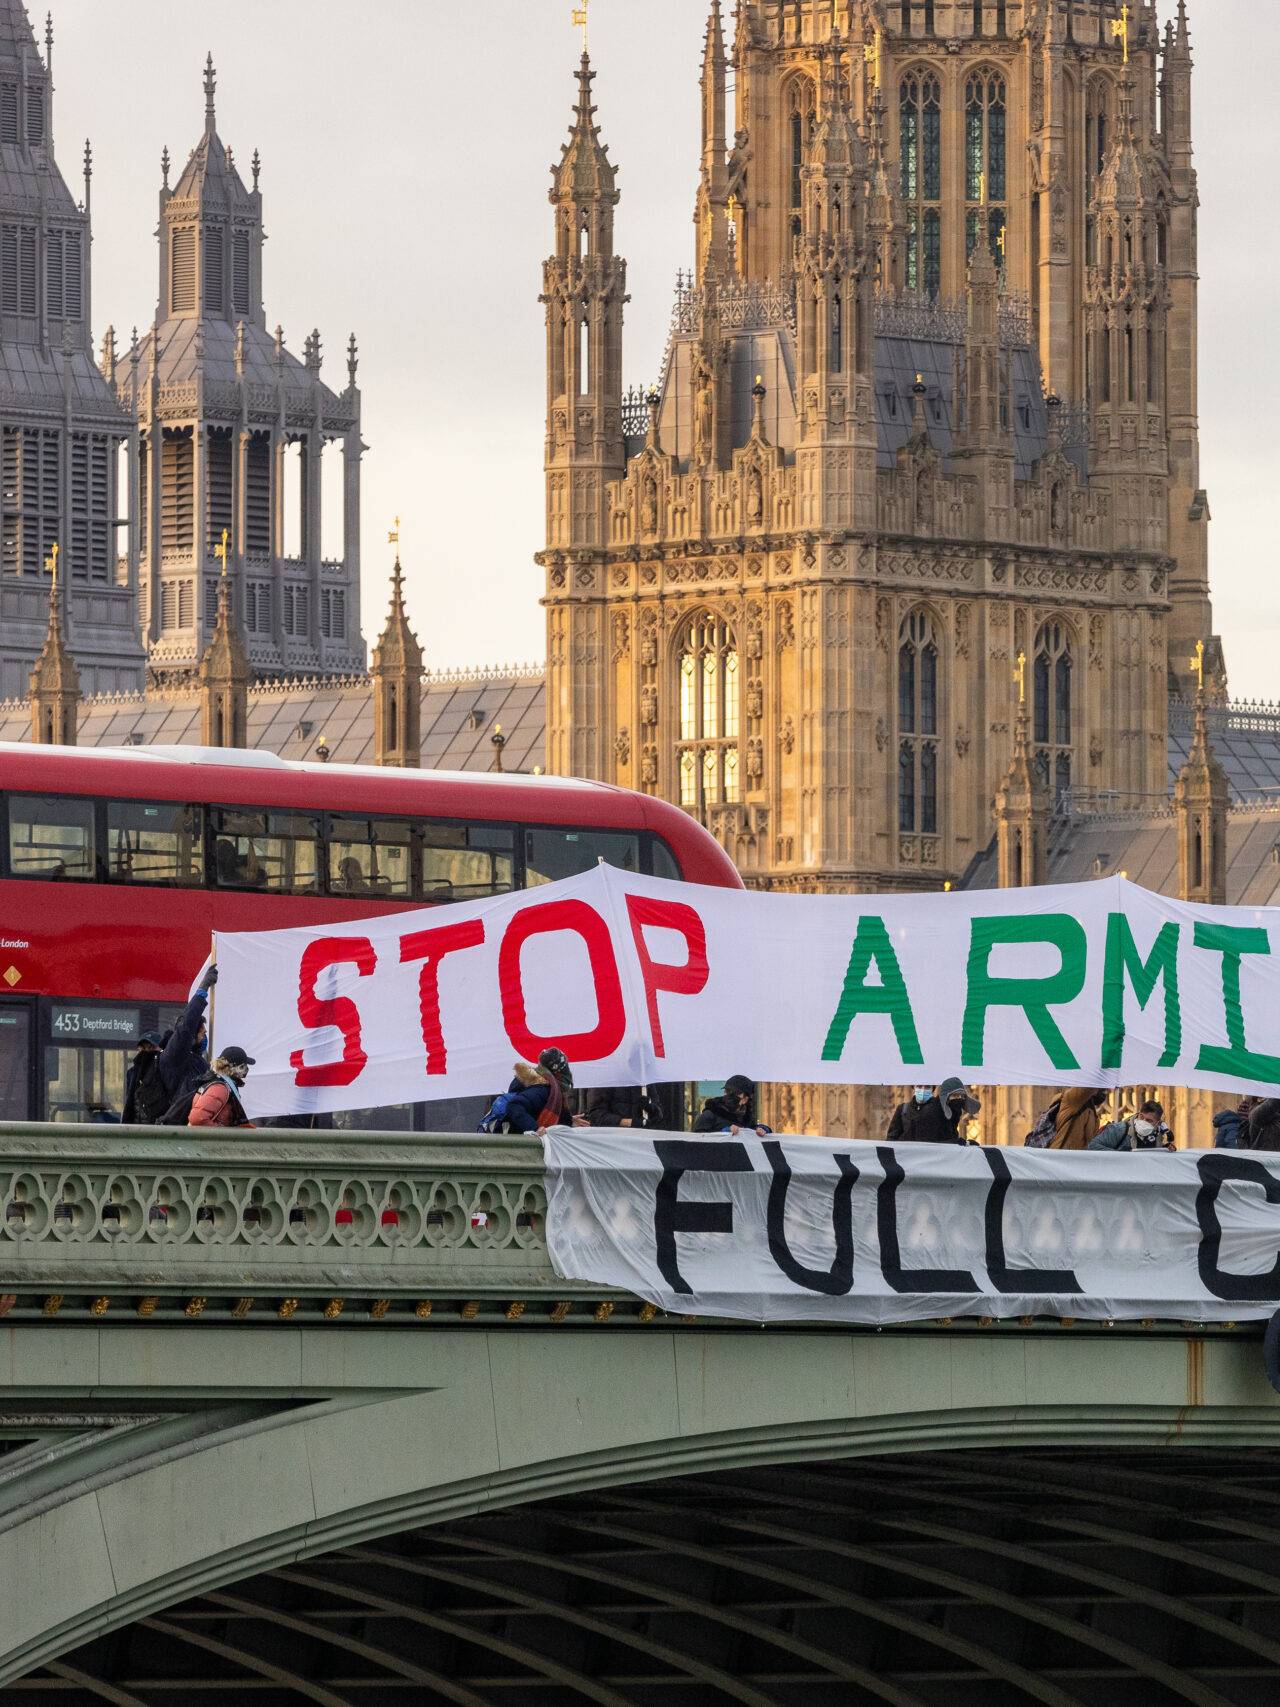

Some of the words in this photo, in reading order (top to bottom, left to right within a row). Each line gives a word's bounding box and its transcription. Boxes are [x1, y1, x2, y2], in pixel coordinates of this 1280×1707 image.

[54, 1013, 80, 1031] 453
[83, 1017, 112, 1031] Deptford
[113, 1019, 134, 1034] Bridge
[291, 893, 711, 1087] STOP
[655, 1141, 1085, 1295] FULL
